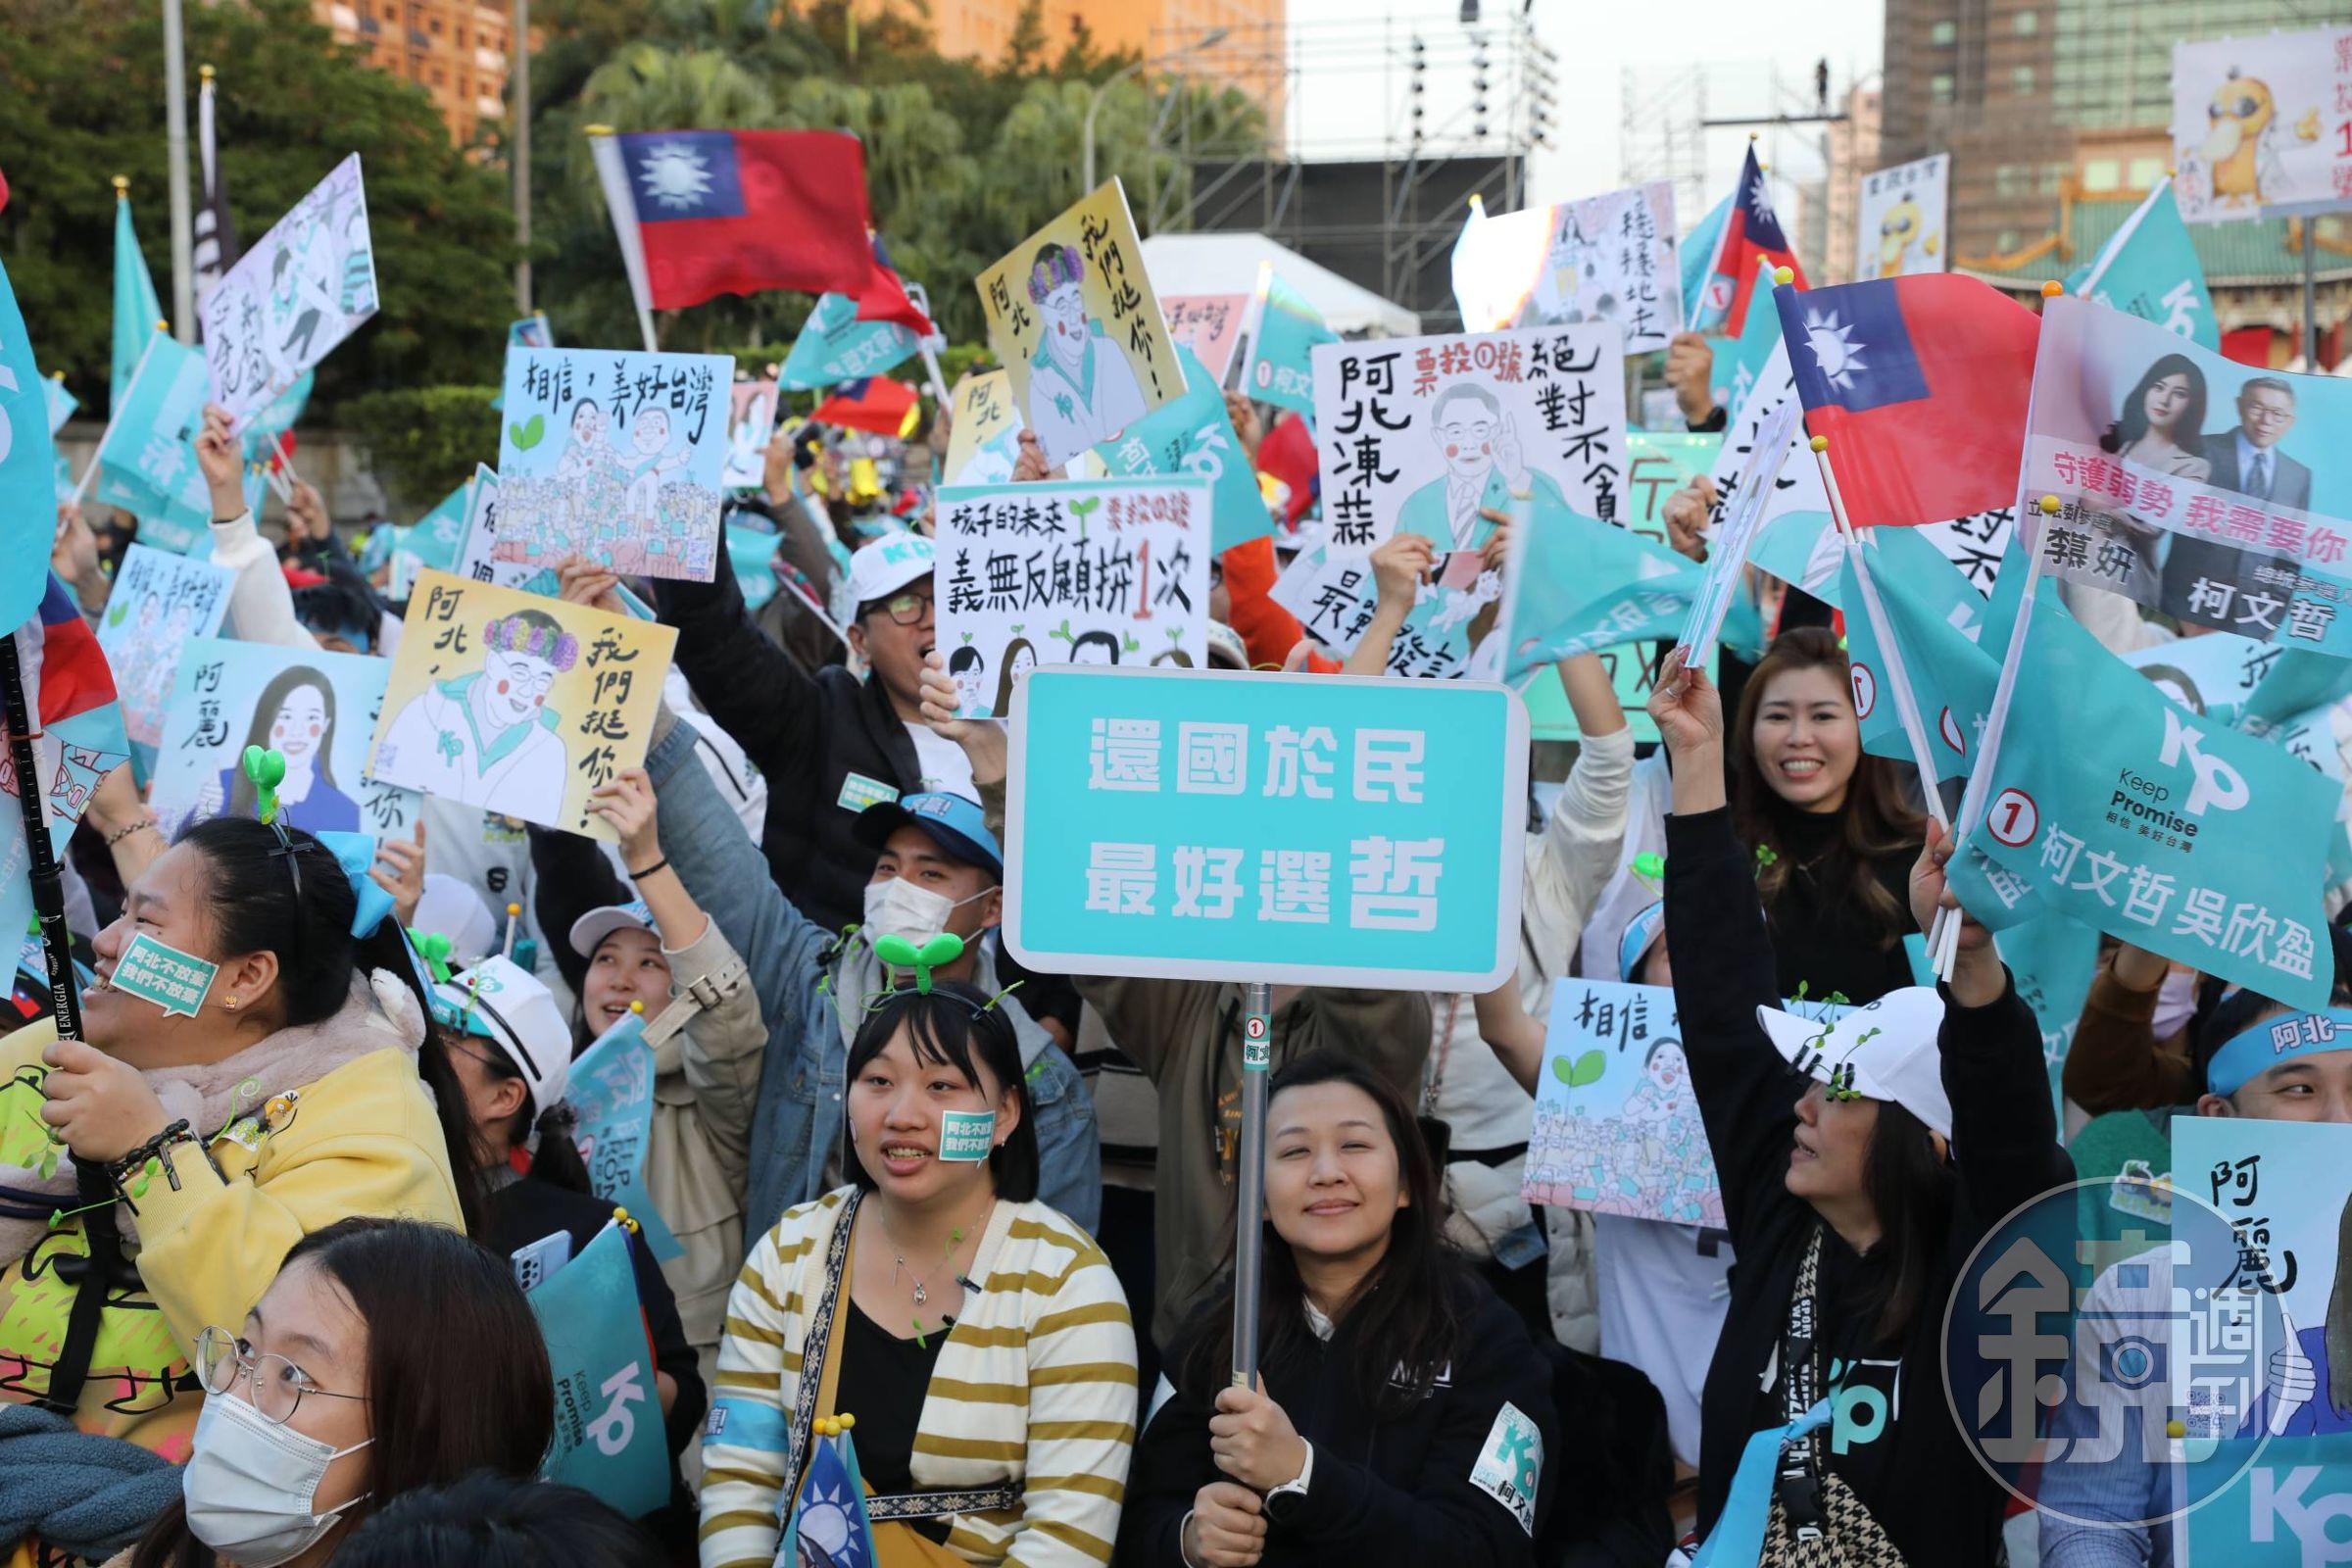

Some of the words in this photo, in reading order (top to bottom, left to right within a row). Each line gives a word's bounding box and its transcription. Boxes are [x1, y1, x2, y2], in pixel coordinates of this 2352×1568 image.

[1332, 352, 1411, 546] 阿北凍蒜
[1527, 334, 1625, 529] 絕對不貪
[951, 495, 1066, 542] 孩子的未來
[2054, 451, 2174, 518] 守護弱勢
[2185, 494, 2349, 565] 我需要你
[2186, 576, 2336, 642] 柯文哲
[1088, 717, 1426, 804] 還國於民
[2119, 768, 2170, 804] Keep
[2110, 790, 2200, 838] Promise
[1085, 835, 1446, 932] 最好選哲
[2040, 822, 2177, 927] 柯文哲
[2172, 887, 2315, 981] 吳欣盈
[121, 962, 201, 1005] 我們不放棄
[129, 946, 209, 989] 阿北不放棄
[53, 983, 73, 1029] ENERGIA
[1791, 1304, 1801, 1338] WAY
[1801, 1299, 1811, 1339] SPORT
[557, 1378, 582, 1447] Promise
[573, 1369, 592, 1411] Keep
